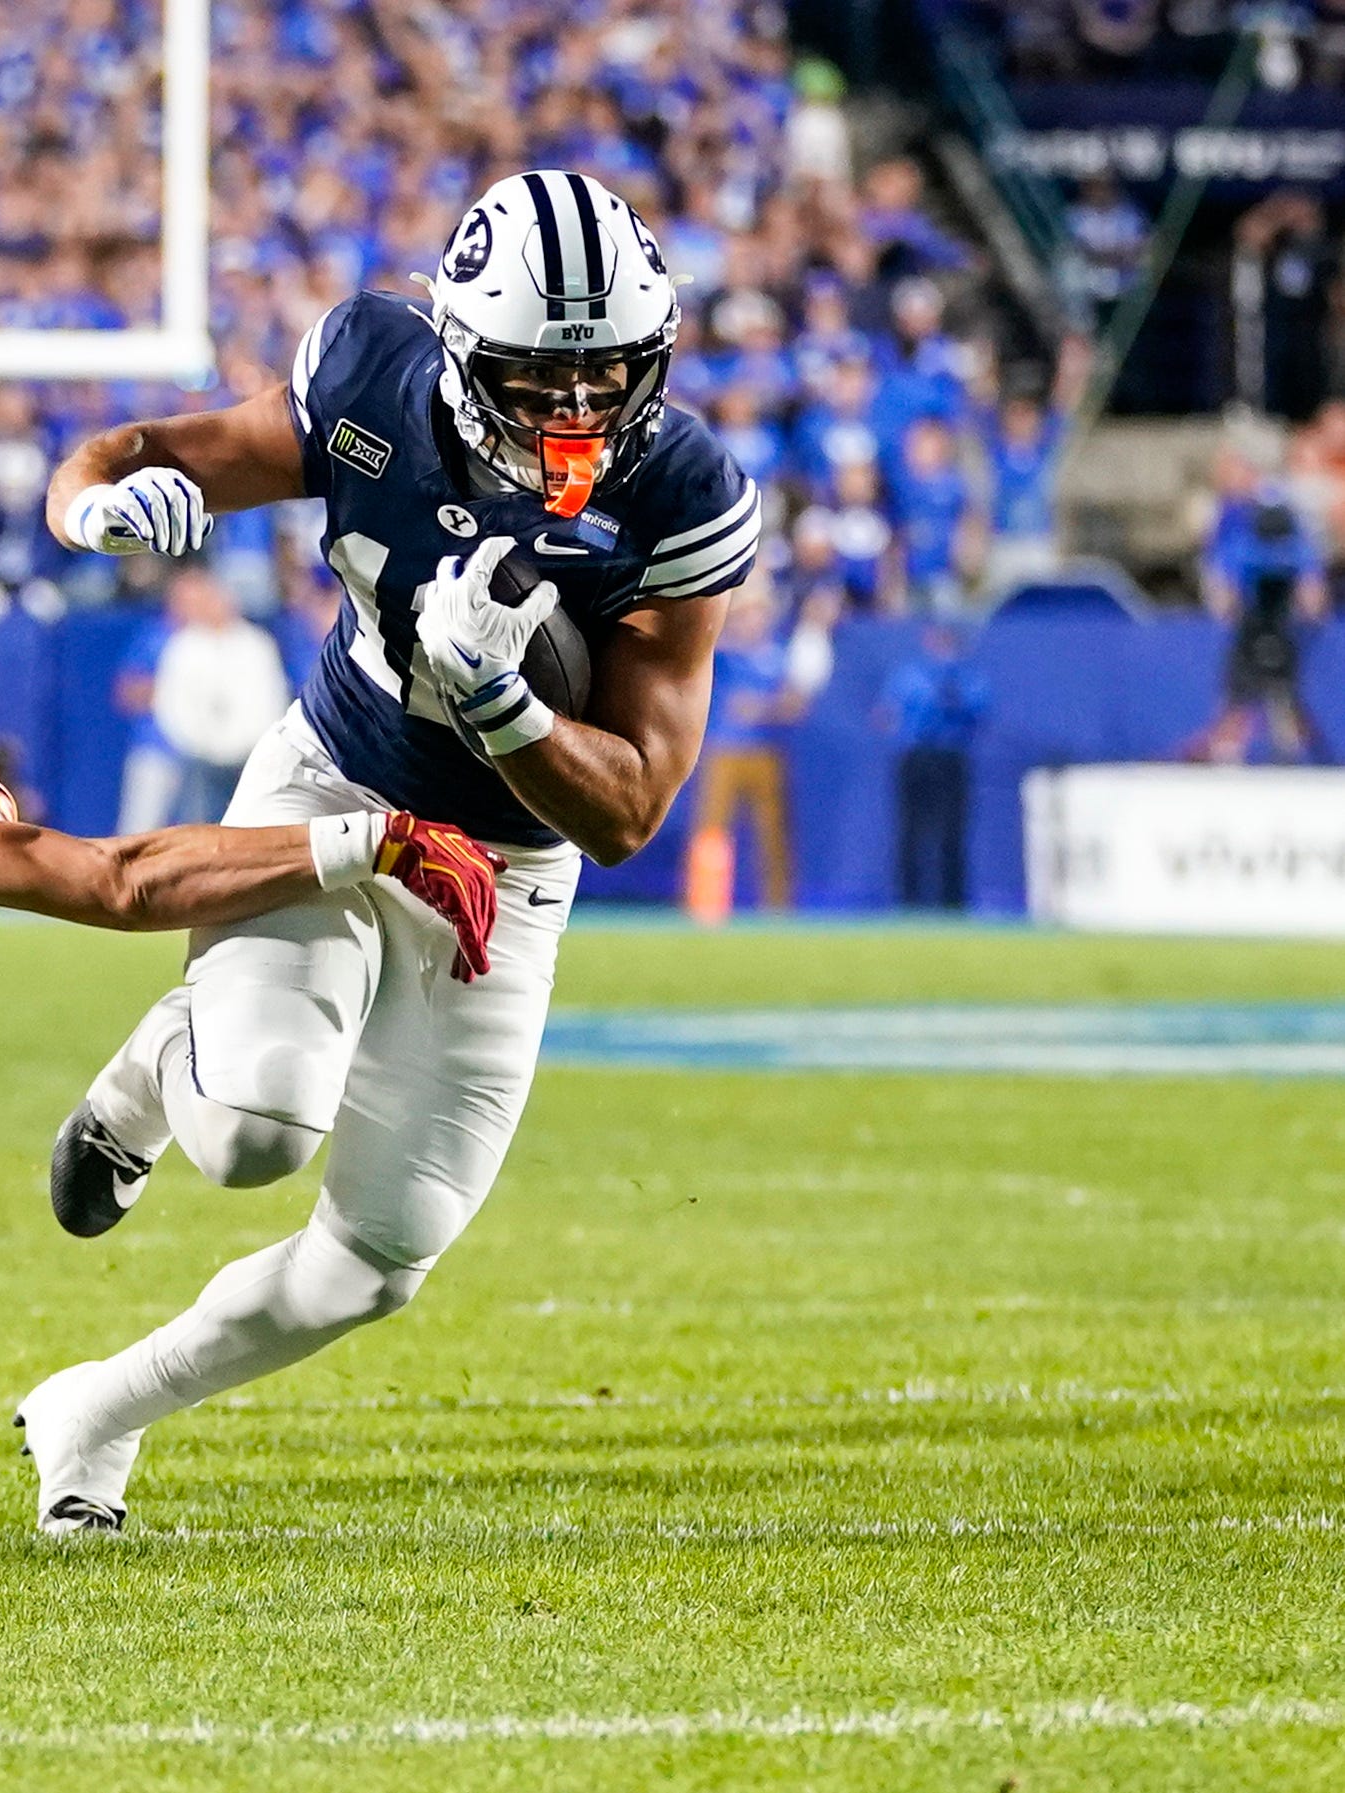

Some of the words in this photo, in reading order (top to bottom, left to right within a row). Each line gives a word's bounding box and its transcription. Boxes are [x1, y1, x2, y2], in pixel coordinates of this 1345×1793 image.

[561, 323, 595, 342] BYU
[445, 509, 472, 532] Y
[580, 511, 620, 535] entrata
